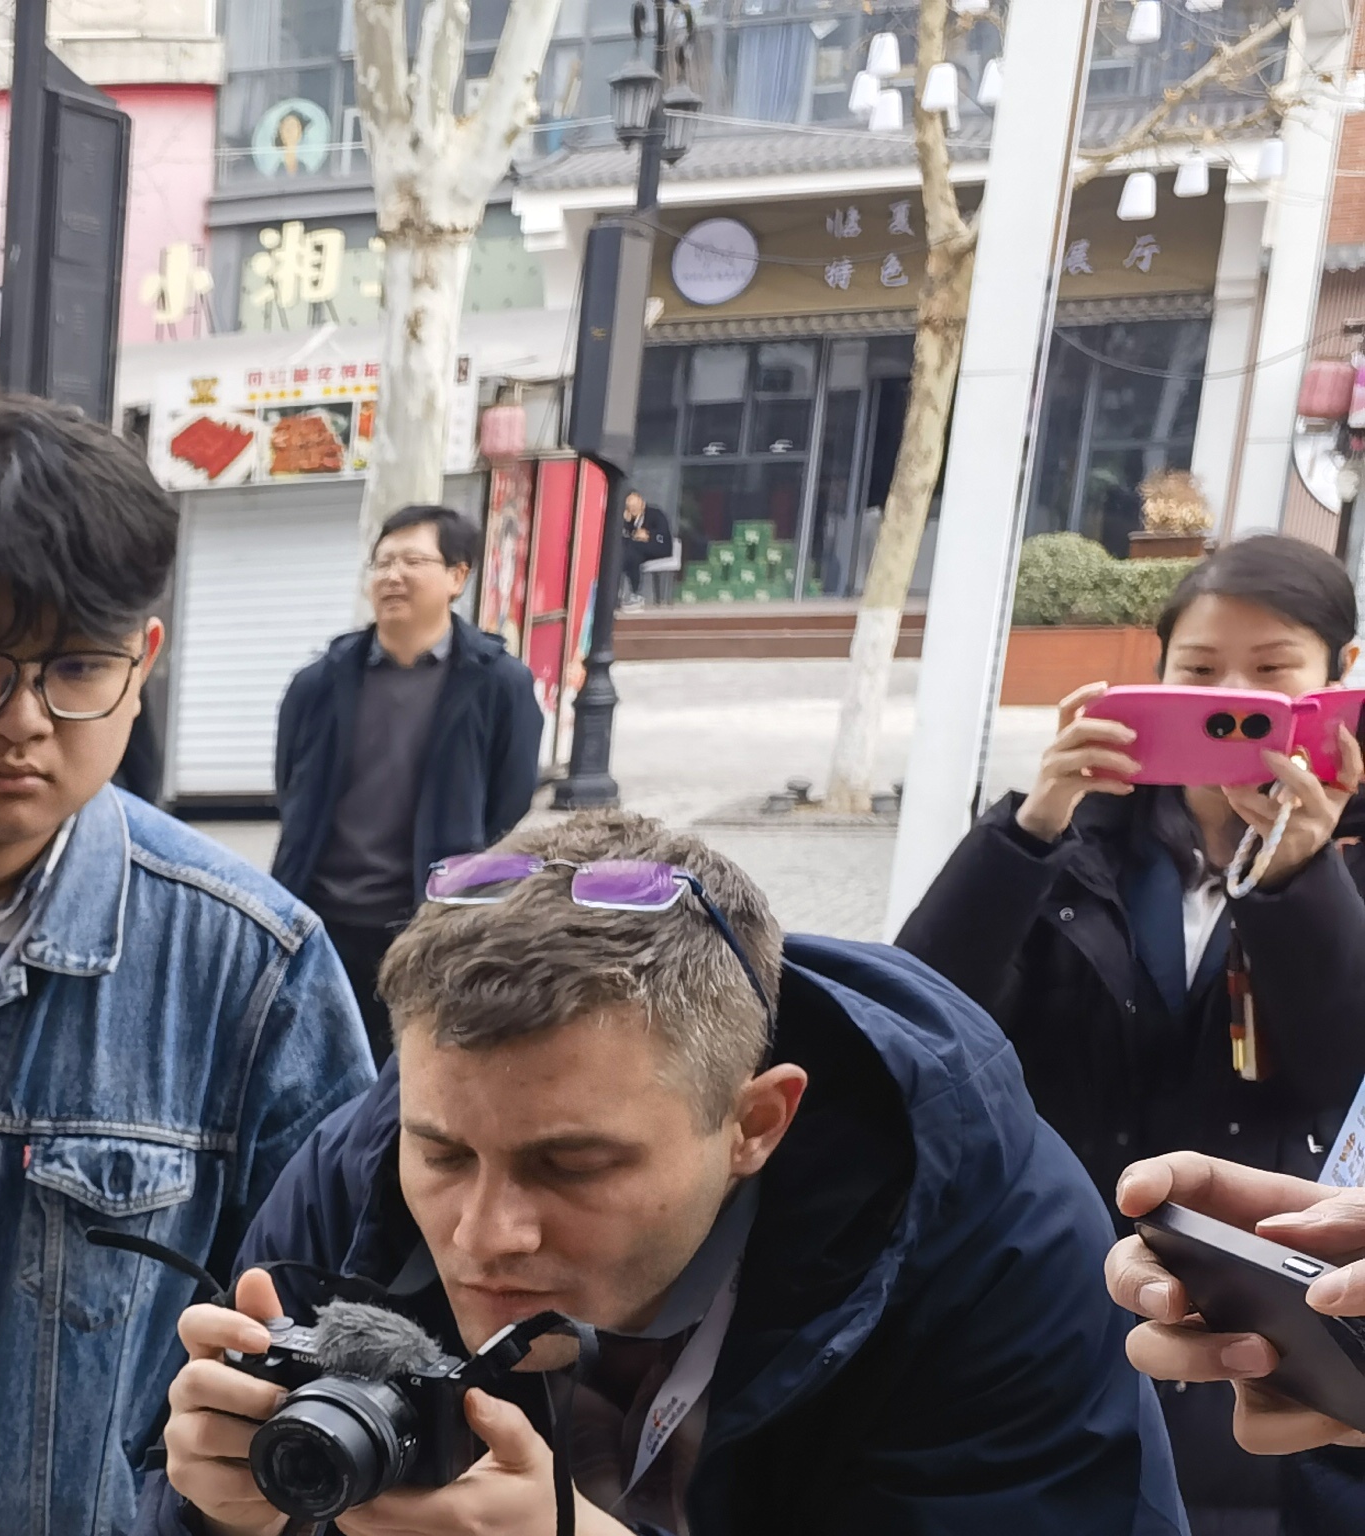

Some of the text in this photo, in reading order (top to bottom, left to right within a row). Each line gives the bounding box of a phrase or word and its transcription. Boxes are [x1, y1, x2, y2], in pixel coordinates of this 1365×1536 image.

[138, 220, 387, 323] 小湘
[1063, 232, 1162, 276] 展厅
[291, 1352, 324, 1367] SONY
